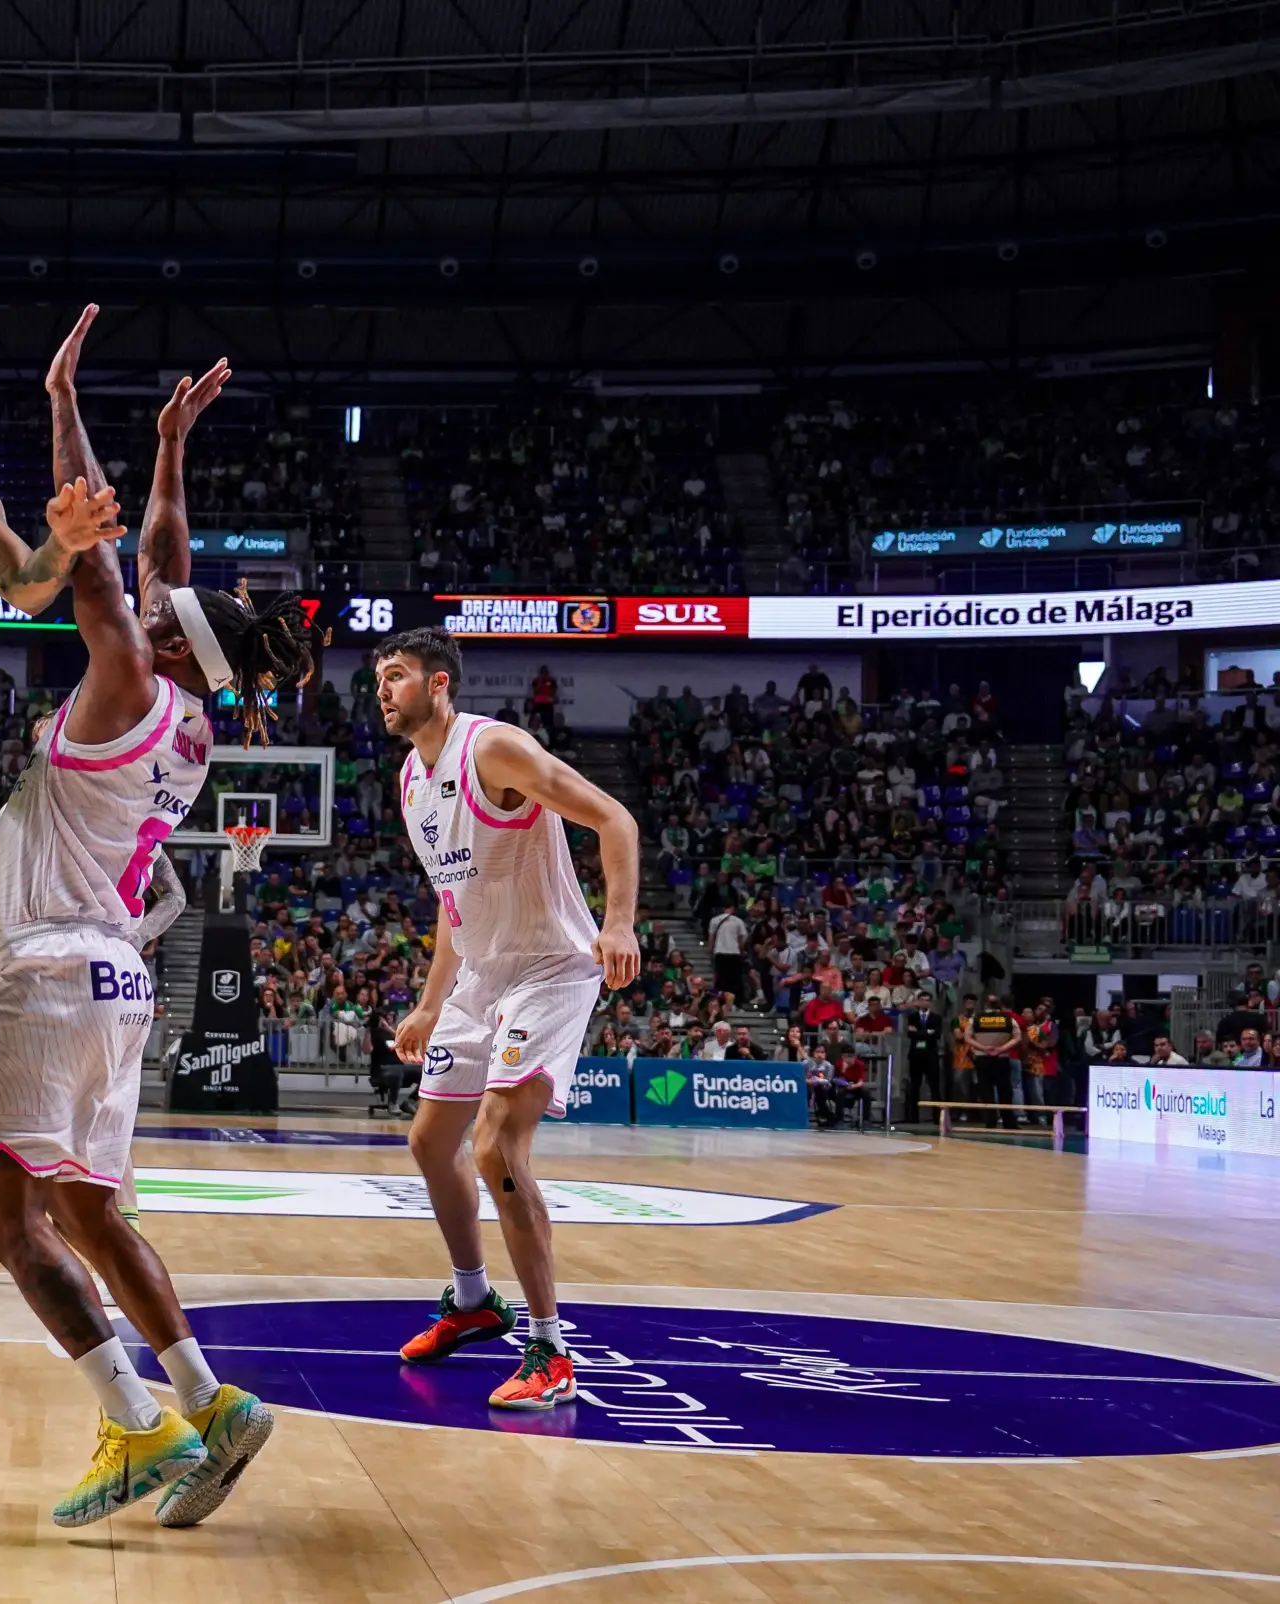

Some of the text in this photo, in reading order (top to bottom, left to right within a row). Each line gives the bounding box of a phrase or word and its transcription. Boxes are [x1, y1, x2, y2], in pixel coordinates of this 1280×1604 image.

[244, 538, 285, 552] Unicaja
[897, 540, 940, 554] Unicaja
[1005, 535, 1049, 551] Unicaja
[1119, 531, 1164, 547] Unicaja
[349, 598, 394, 632] 36
[461, 600, 558, 616] DREAMLAND
[638, 603, 722, 623] SUR
[837, 594, 1194, 634] El periódico de Málaga
[445, 615, 558, 633] GRAN CANARIA
[693, 1072, 799, 1093] Fundación
[693, 1092, 770, 1116] Unicaja
[1097, 1085, 1141, 1115] Hospital
[1155, 1090, 1227, 1120] quirónsalud
[1197, 1124, 1227, 1145] Málaga
